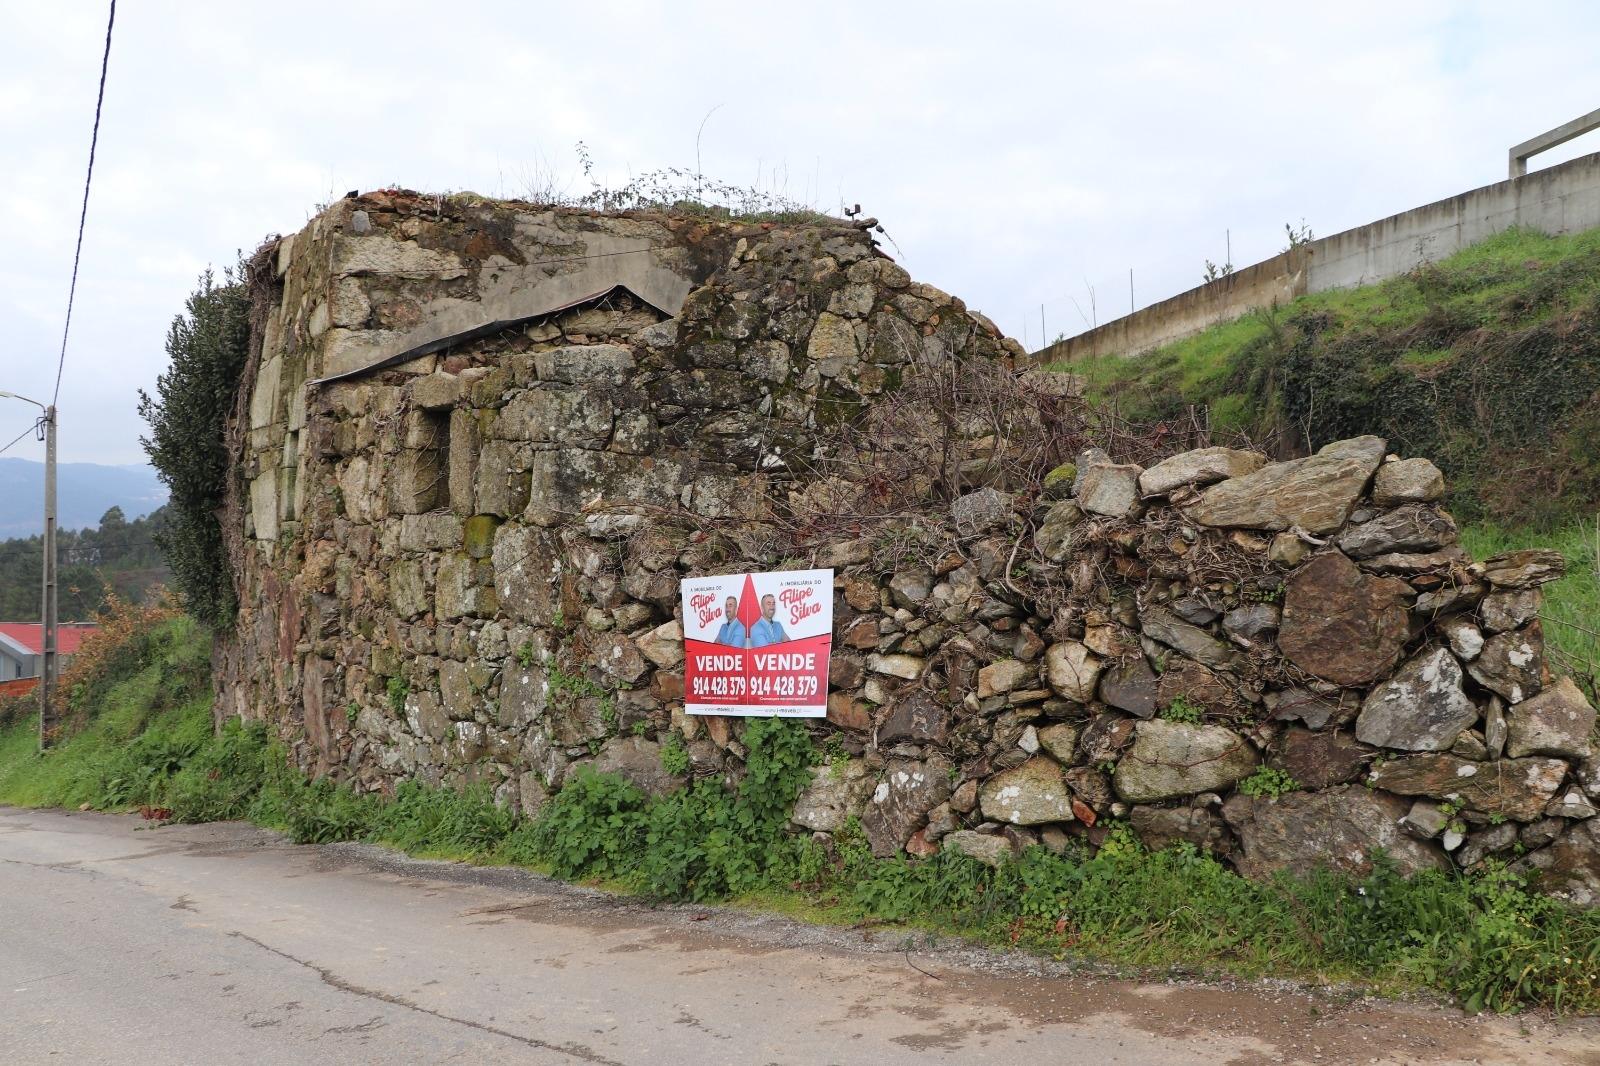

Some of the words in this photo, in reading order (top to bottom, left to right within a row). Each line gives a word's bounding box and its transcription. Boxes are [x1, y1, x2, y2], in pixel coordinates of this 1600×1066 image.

[690, 593, 716, 613] Filipe
[779, 587, 814, 608] Filipe
[699, 607, 722, 628] Silva
[790, 602, 821, 625] Silva
[695, 654, 743, 671] VENDE
[754, 653, 815, 670] VENDE
[693, 676, 709, 695] 914
[711, 676, 728, 695] 428
[730, 676, 746, 695] 379
[750, 676, 770, 695] 914
[773, 676, 794, 695] 428
[797, 675, 817, 695] 379
